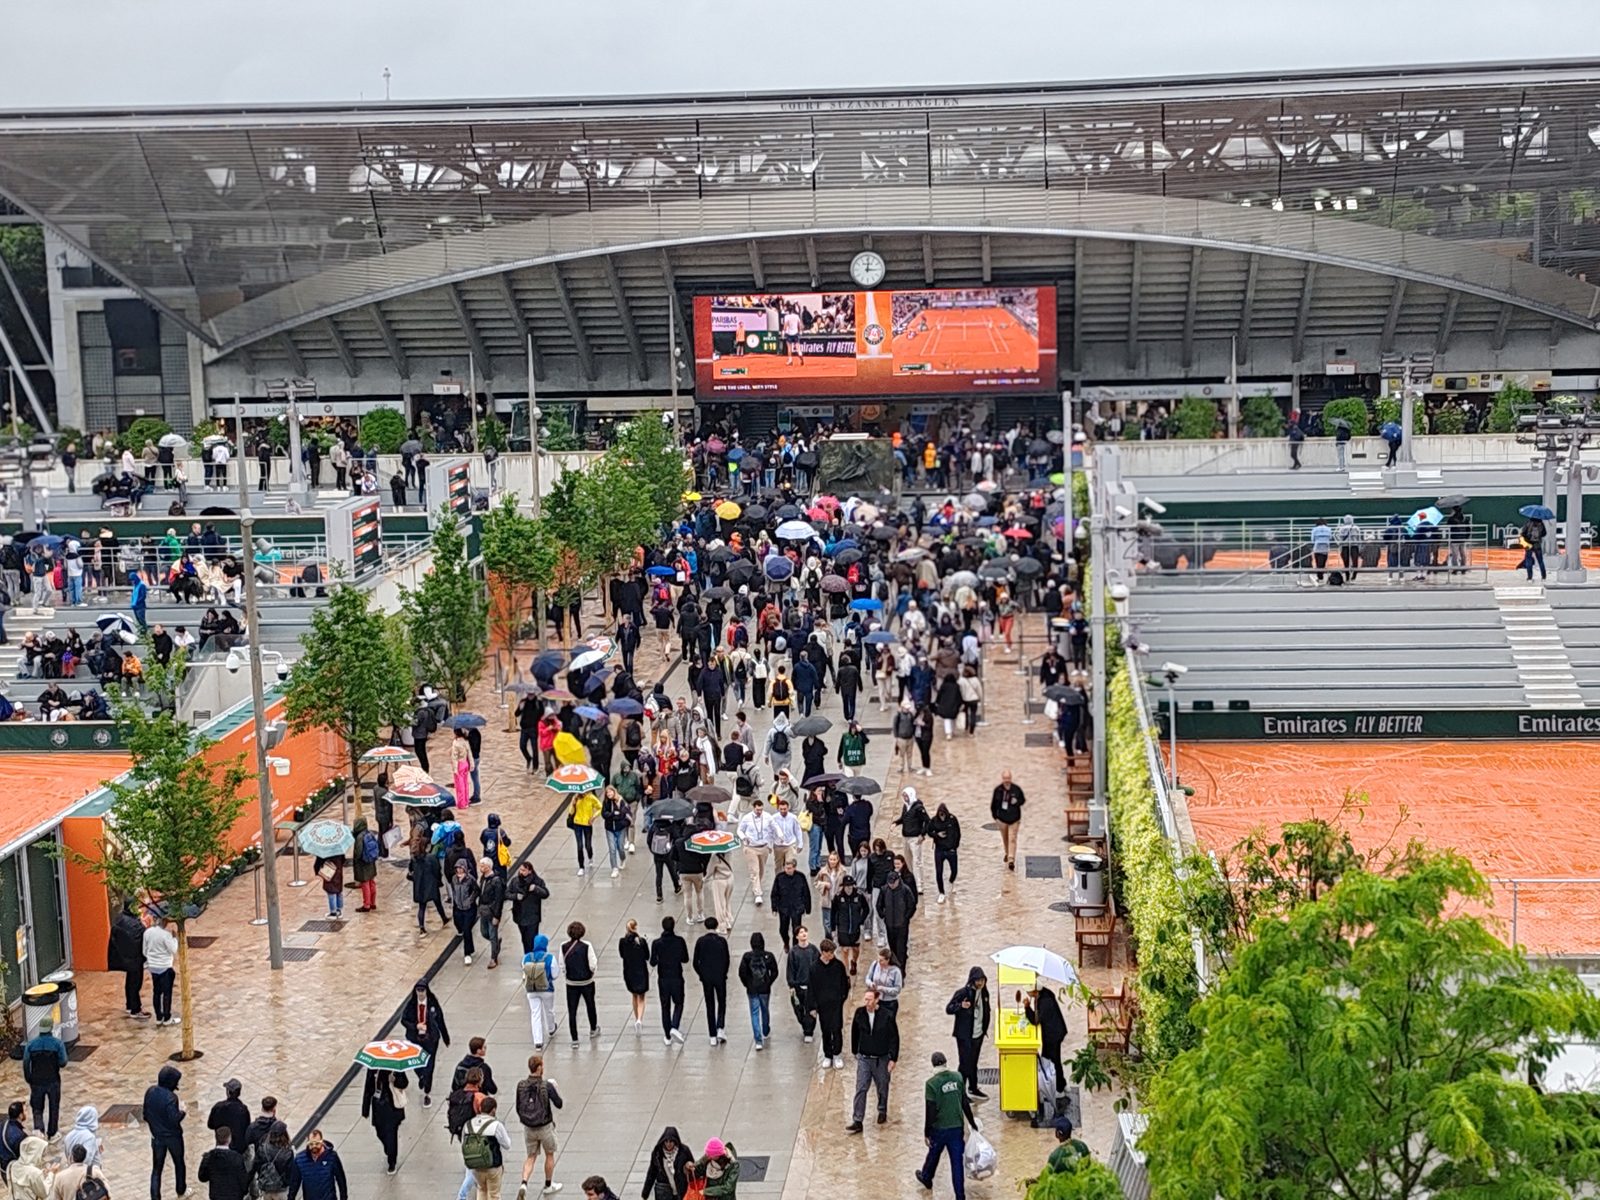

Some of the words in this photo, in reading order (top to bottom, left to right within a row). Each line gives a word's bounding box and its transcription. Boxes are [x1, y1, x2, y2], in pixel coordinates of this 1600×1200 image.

[780, 102, 821, 111] COURT
[1263, 716, 1347, 734] Emirates
[1354, 716, 1376, 733] FLY
[1378, 715, 1423, 733] BETTER
